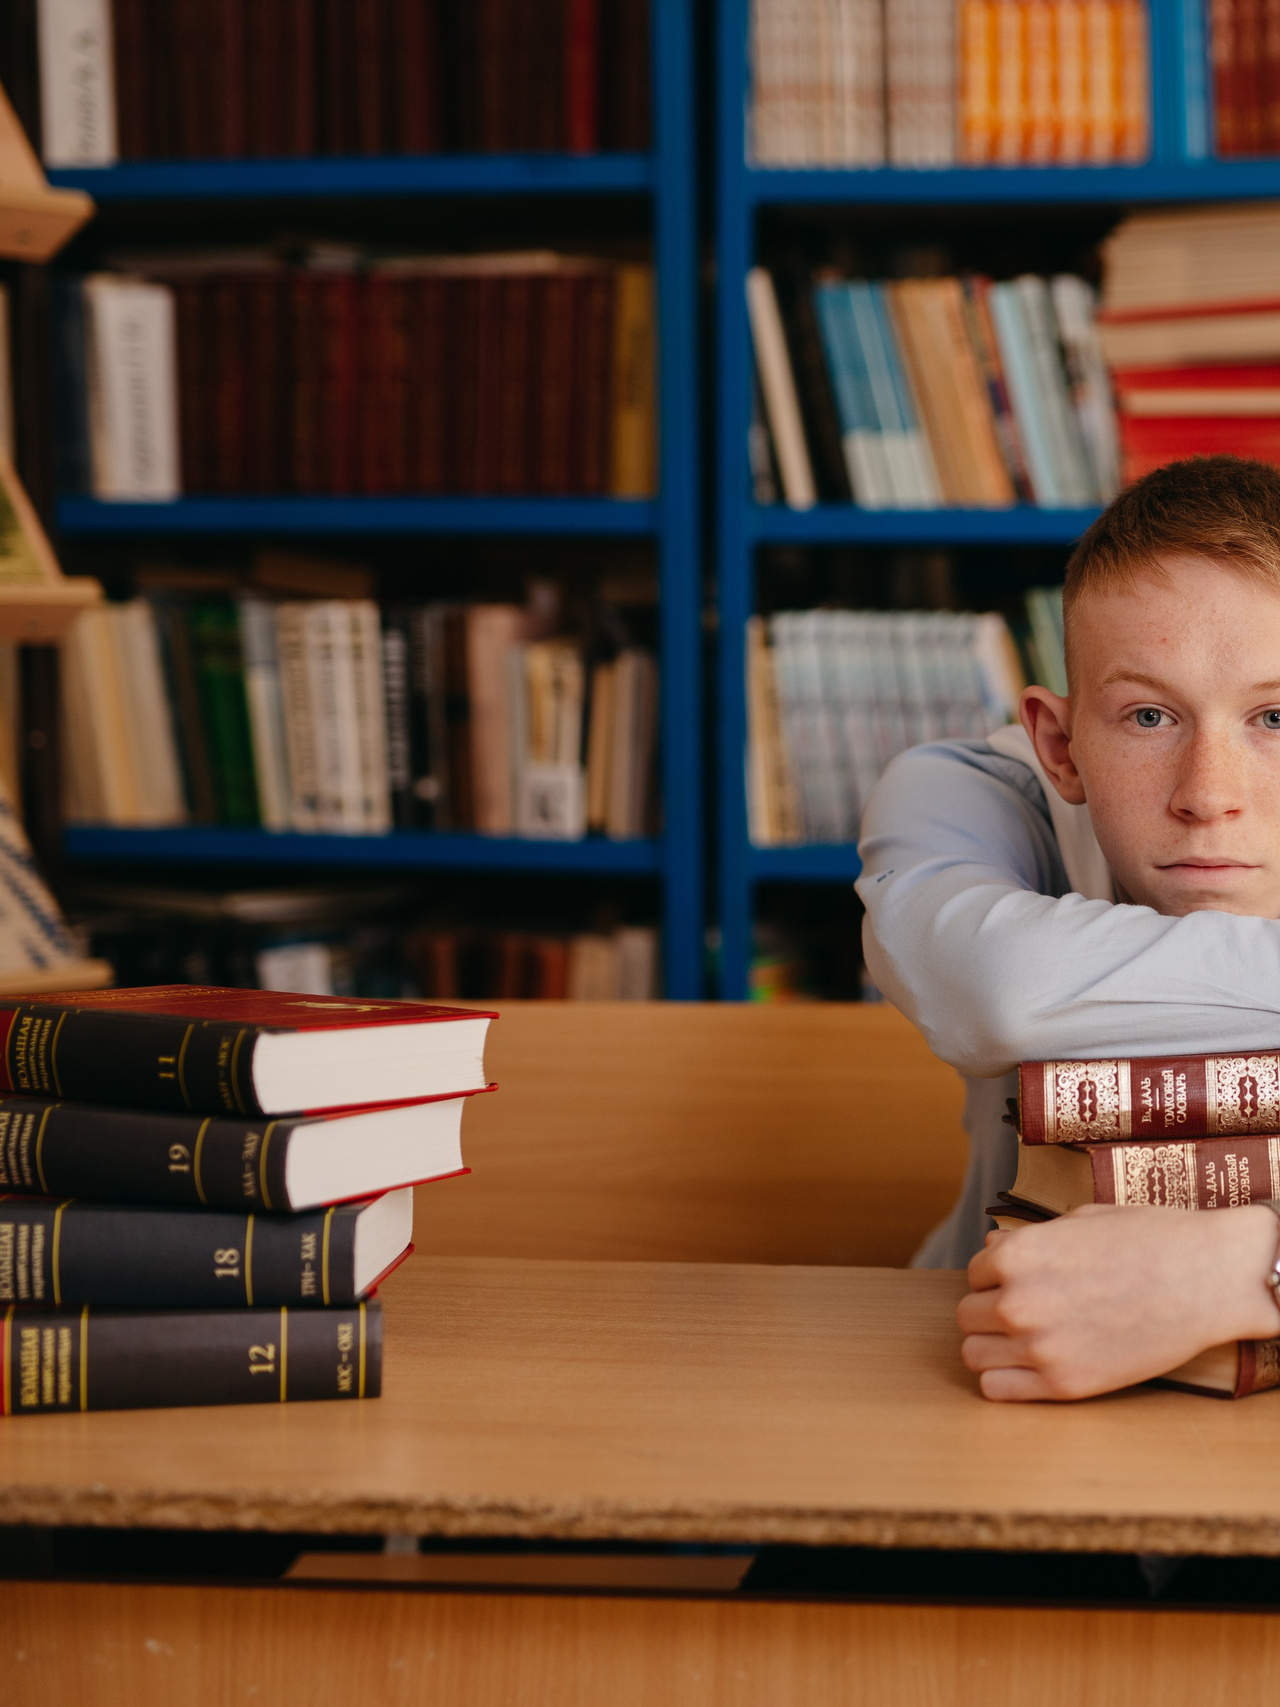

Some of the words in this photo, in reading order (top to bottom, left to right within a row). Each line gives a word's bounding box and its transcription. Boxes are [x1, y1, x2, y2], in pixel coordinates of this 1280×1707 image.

[15, 1017, 33, 1089] БОЛЬШАЯ
[158, 1056, 176, 1079] 11
[1141, 1077, 1153, 1107] ДАЛЬ
[1161, 1069, 1175, 1128] ТОЛКОВЫЙ
[1176, 1073, 1187, 1124] СЛОВАРЬ
[168, 1143, 191, 1174] 19
[1205, 1161, 1218, 1193] ДАЛЬ
[1224, 1153, 1239, 1208] ОЛКОВЫЙ
[213, 1247, 240, 1279] 18
[248, 1343, 276, 1376] 12
